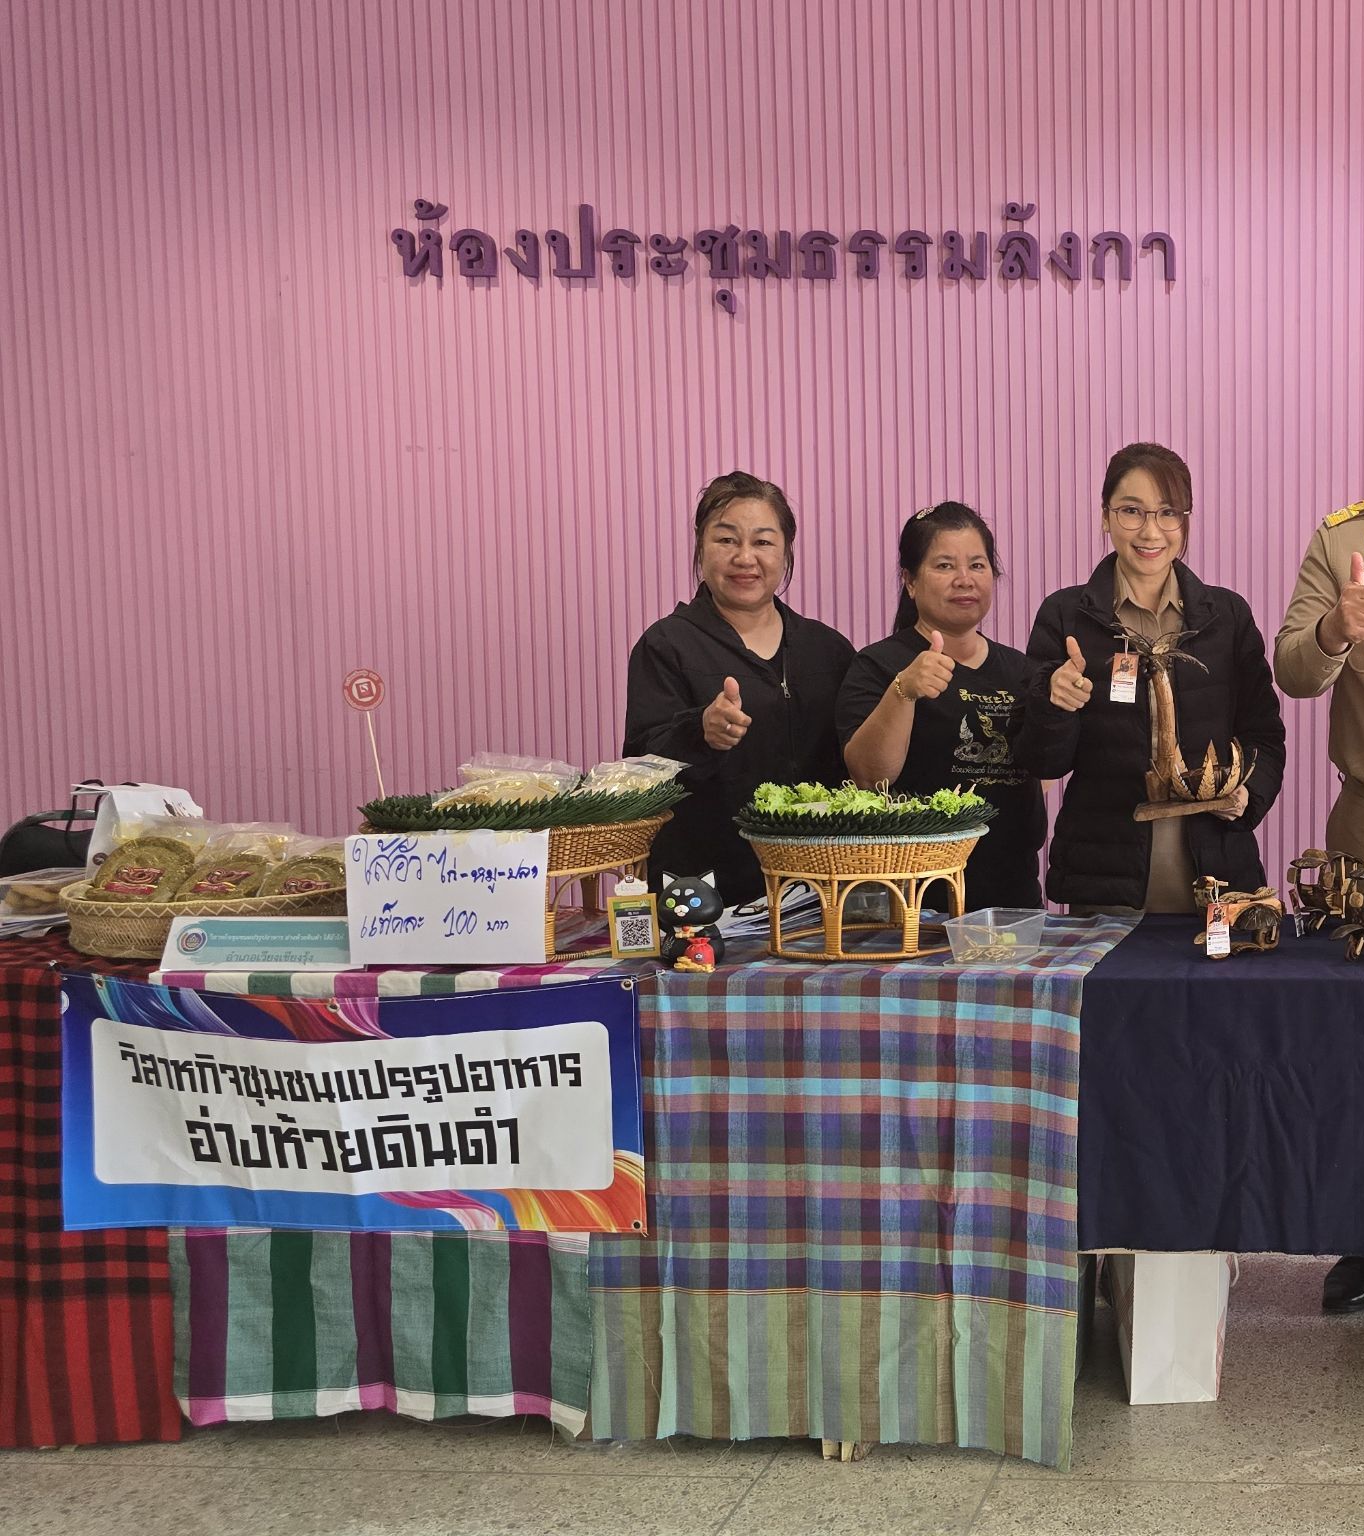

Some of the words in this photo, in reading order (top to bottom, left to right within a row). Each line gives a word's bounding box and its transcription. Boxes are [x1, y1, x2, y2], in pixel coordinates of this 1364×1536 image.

[391, 199, 1177, 314] ห้องประชุมธรรมลังกา
[443, 906, 478, 938] 100
[486, 919, 509, 933] บาท
[118, 1041, 582, 1107] วิสาหกิจชุมชนแปรรูปอาหาร
[185, 1105, 520, 1174] อ่างห้วยดินดำ
